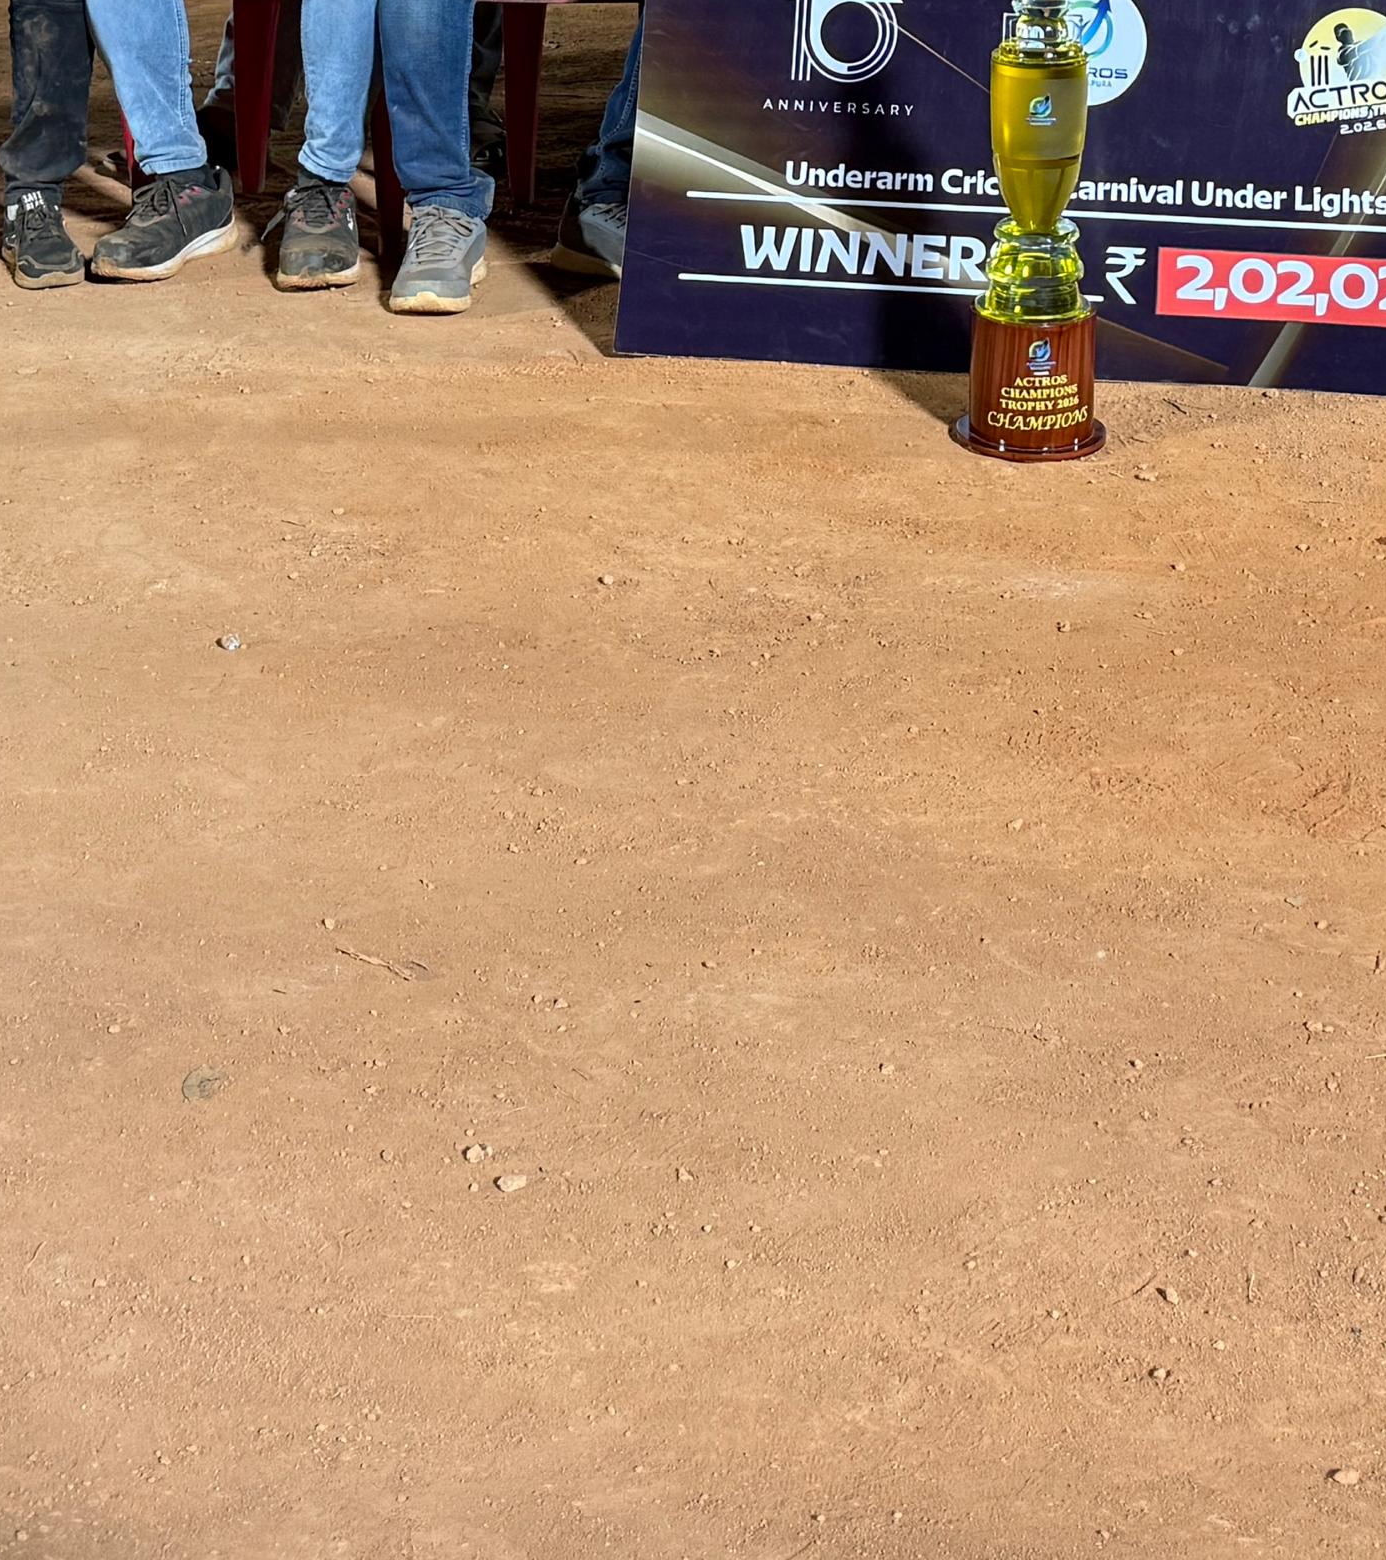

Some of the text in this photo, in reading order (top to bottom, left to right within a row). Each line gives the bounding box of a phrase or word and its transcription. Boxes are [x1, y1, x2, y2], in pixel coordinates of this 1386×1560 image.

[1088, 66, 1129, 80] ROS
[763, 97, 915, 117] ANNIVERSARY
[1294, 105, 1371, 127] CHAMPIONS
[785, 160, 933, 193] Underarm
[941, 168, 999, 196] Cric
[1070, 177, 1183, 206] arnival
[1191, 179, 1288, 212] Under
[739, 224, 991, 282] WINNER
[1000, 383, 1079, 400] CHAMPIONS
[1014, 375, 1068, 388] ACTROS
[999, 398, 1055, 411] TROPHY
[987, 405, 1089, 431] CHAMPIONS
